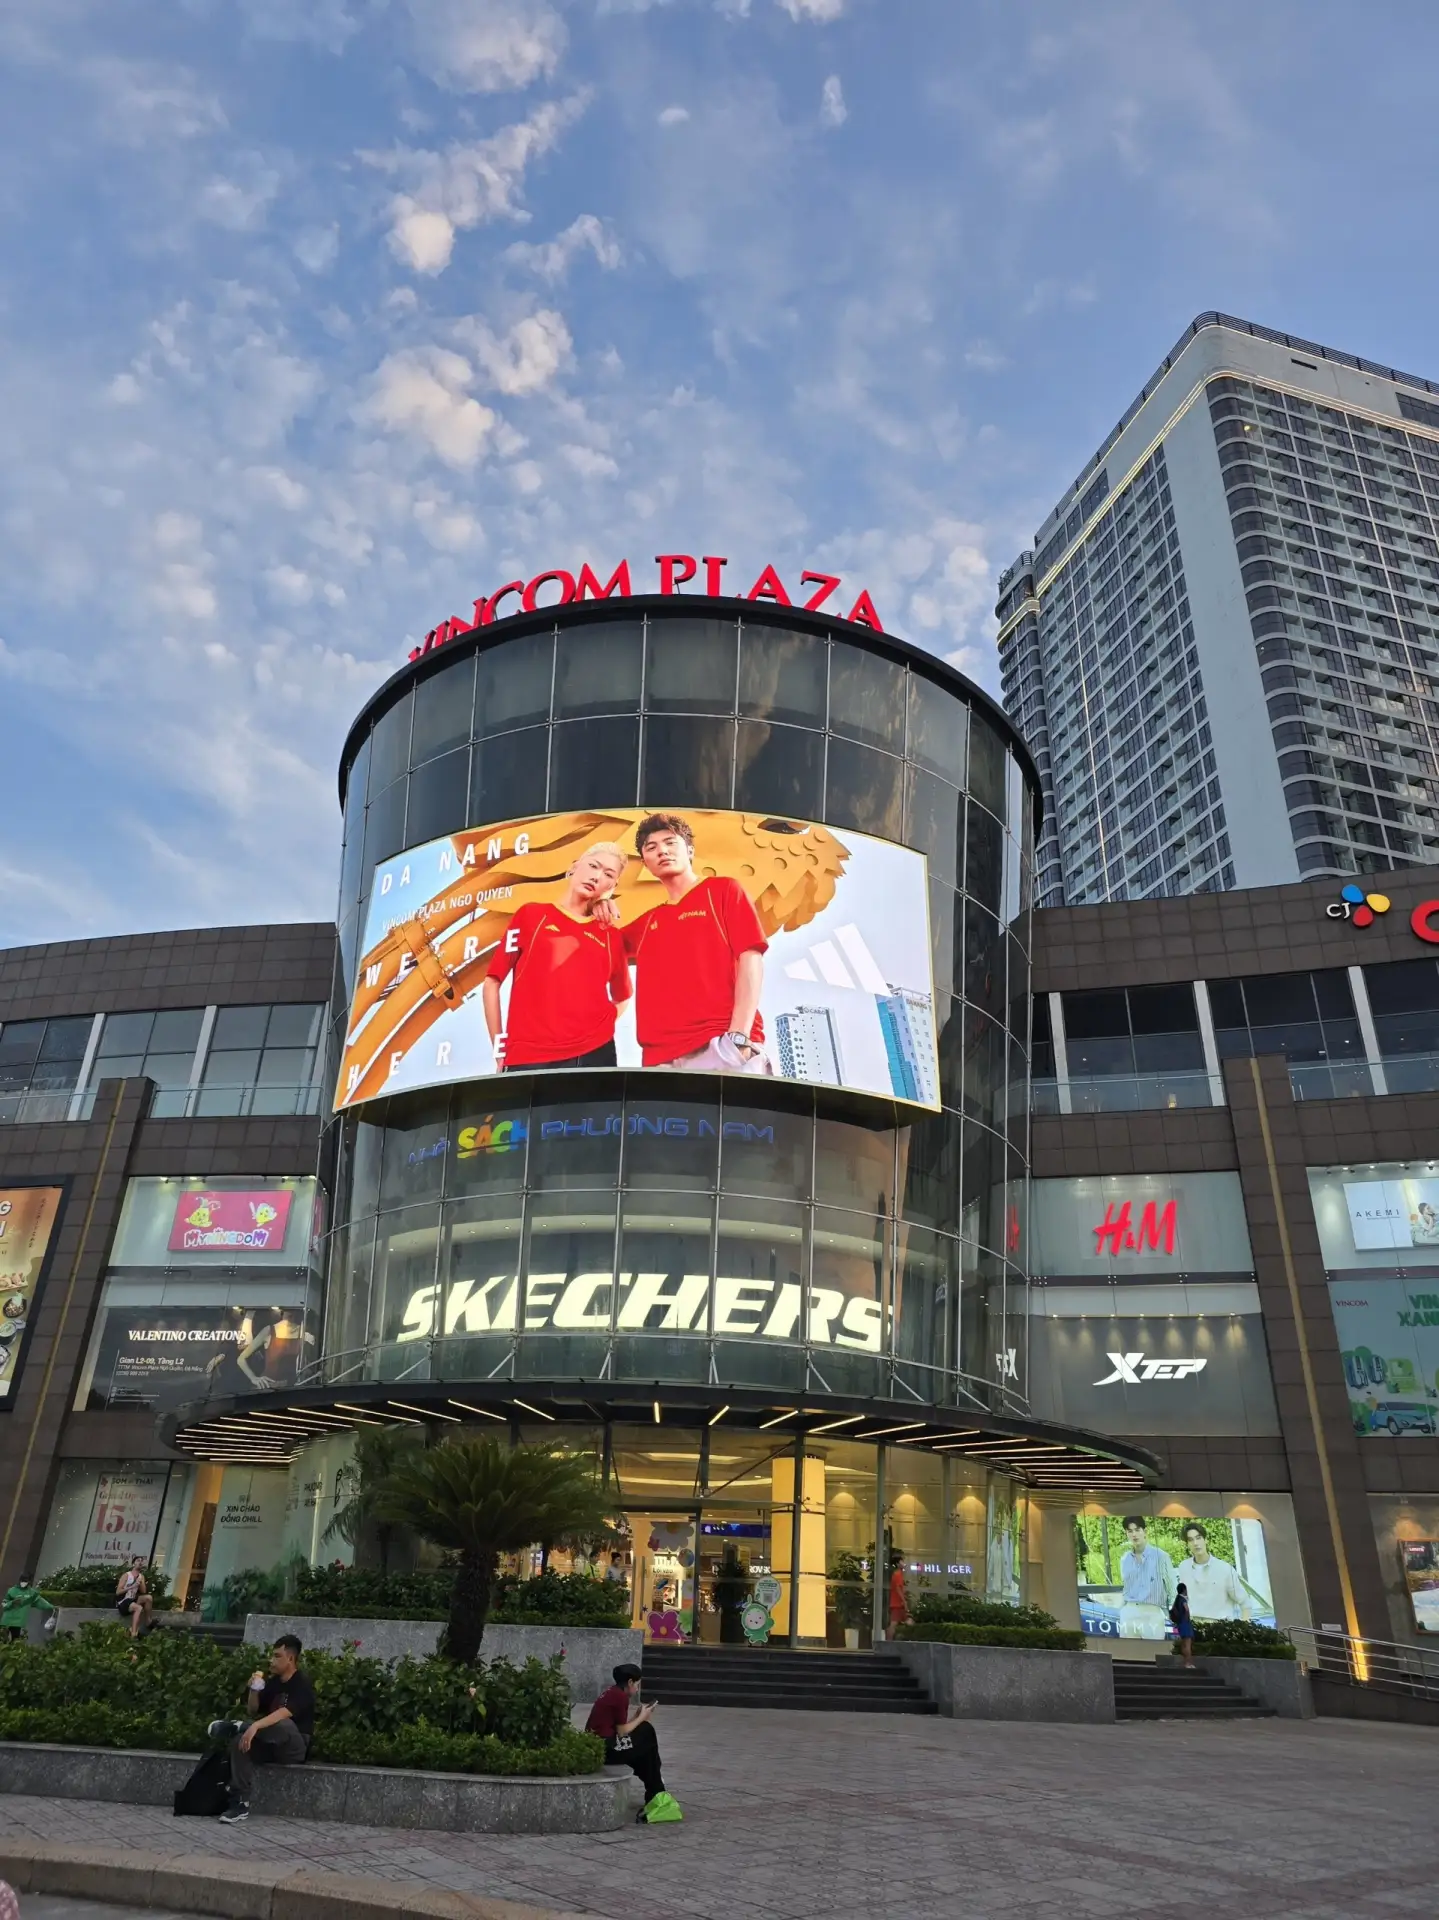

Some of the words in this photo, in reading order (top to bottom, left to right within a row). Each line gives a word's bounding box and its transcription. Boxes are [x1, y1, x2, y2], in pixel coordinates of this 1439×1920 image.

[655, 554, 883, 632] PLAZA
[381, 865, 411, 895] DA
[439, 833, 530, 872] NANG
[382, 909, 418, 932] VINCOM
[418, 901, 447, 920] PLAZA
[450, 893, 473, 909] NGO
[476, 886, 513, 905] QUYEN
[1326, 903, 1350, 919] CJ
[347, 1033, 509, 1089] HERE
[1093, 1200, 1178, 1256] H&M
[1356, 1209, 1400, 1218] AKEMI
[397, 1273, 892, 1352] SKECHERS
[1336, 1299, 1369, 1307] VINCOM
[129, 1330, 186, 1341] VALENTINO
[188, 1330, 246, 1341] CREATIONS
[1092, 1352, 1208, 1386] XTEP
[94, 1503, 125, 1534] 15
[126, 1520, 153, 1534] OFF
[242, 1515, 262, 1523] CHILL
[1085, 1619, 1159, 1636] TOMMY
